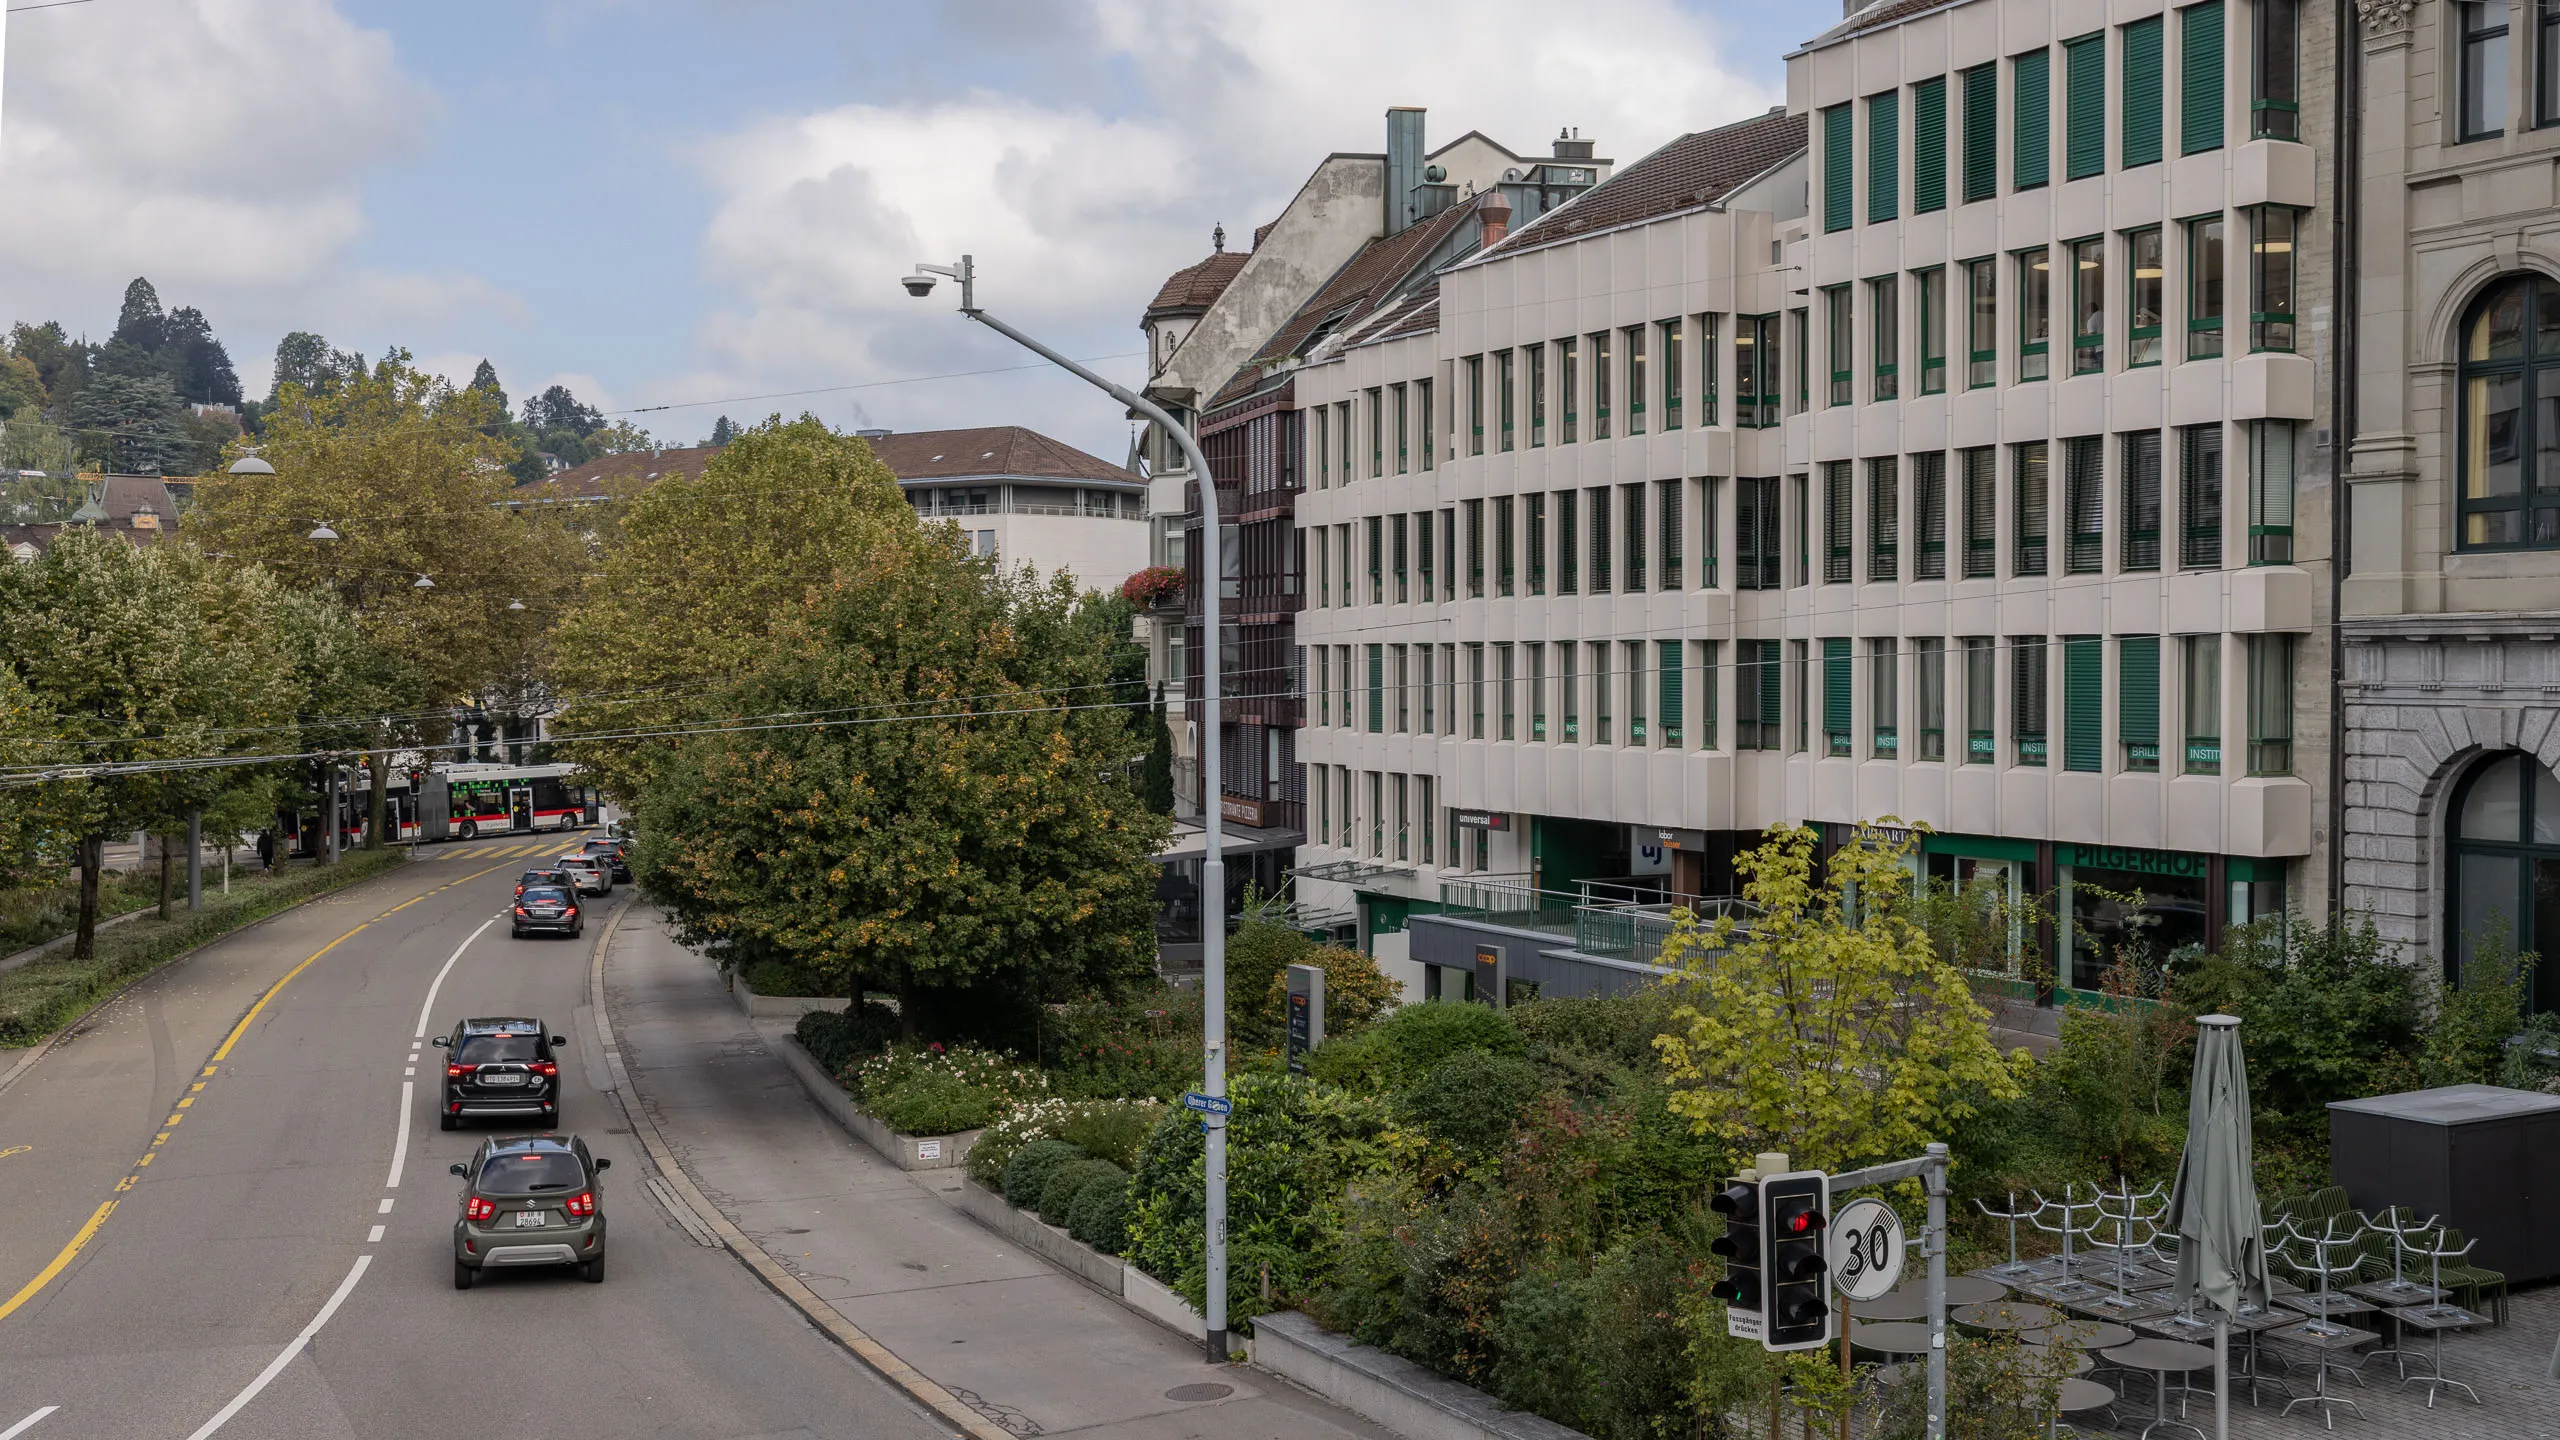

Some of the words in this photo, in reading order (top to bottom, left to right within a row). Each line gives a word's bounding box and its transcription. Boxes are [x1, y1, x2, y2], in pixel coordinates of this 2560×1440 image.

[1658, 829, 1674, 840] labor
[2074, 845, 2206, 875] PILGERHOF
[1477, 953, 1496, 965] coop
[1188, 1095, 1207, 1108] Oberer
[1207, 1099, 1228, 1112] Gben
[1845, 1225, 1889, 1277] 30
[1729, 1314, 1762, 1326] Fussgänger
[1735, 1324, 1758, 1334] drücken
